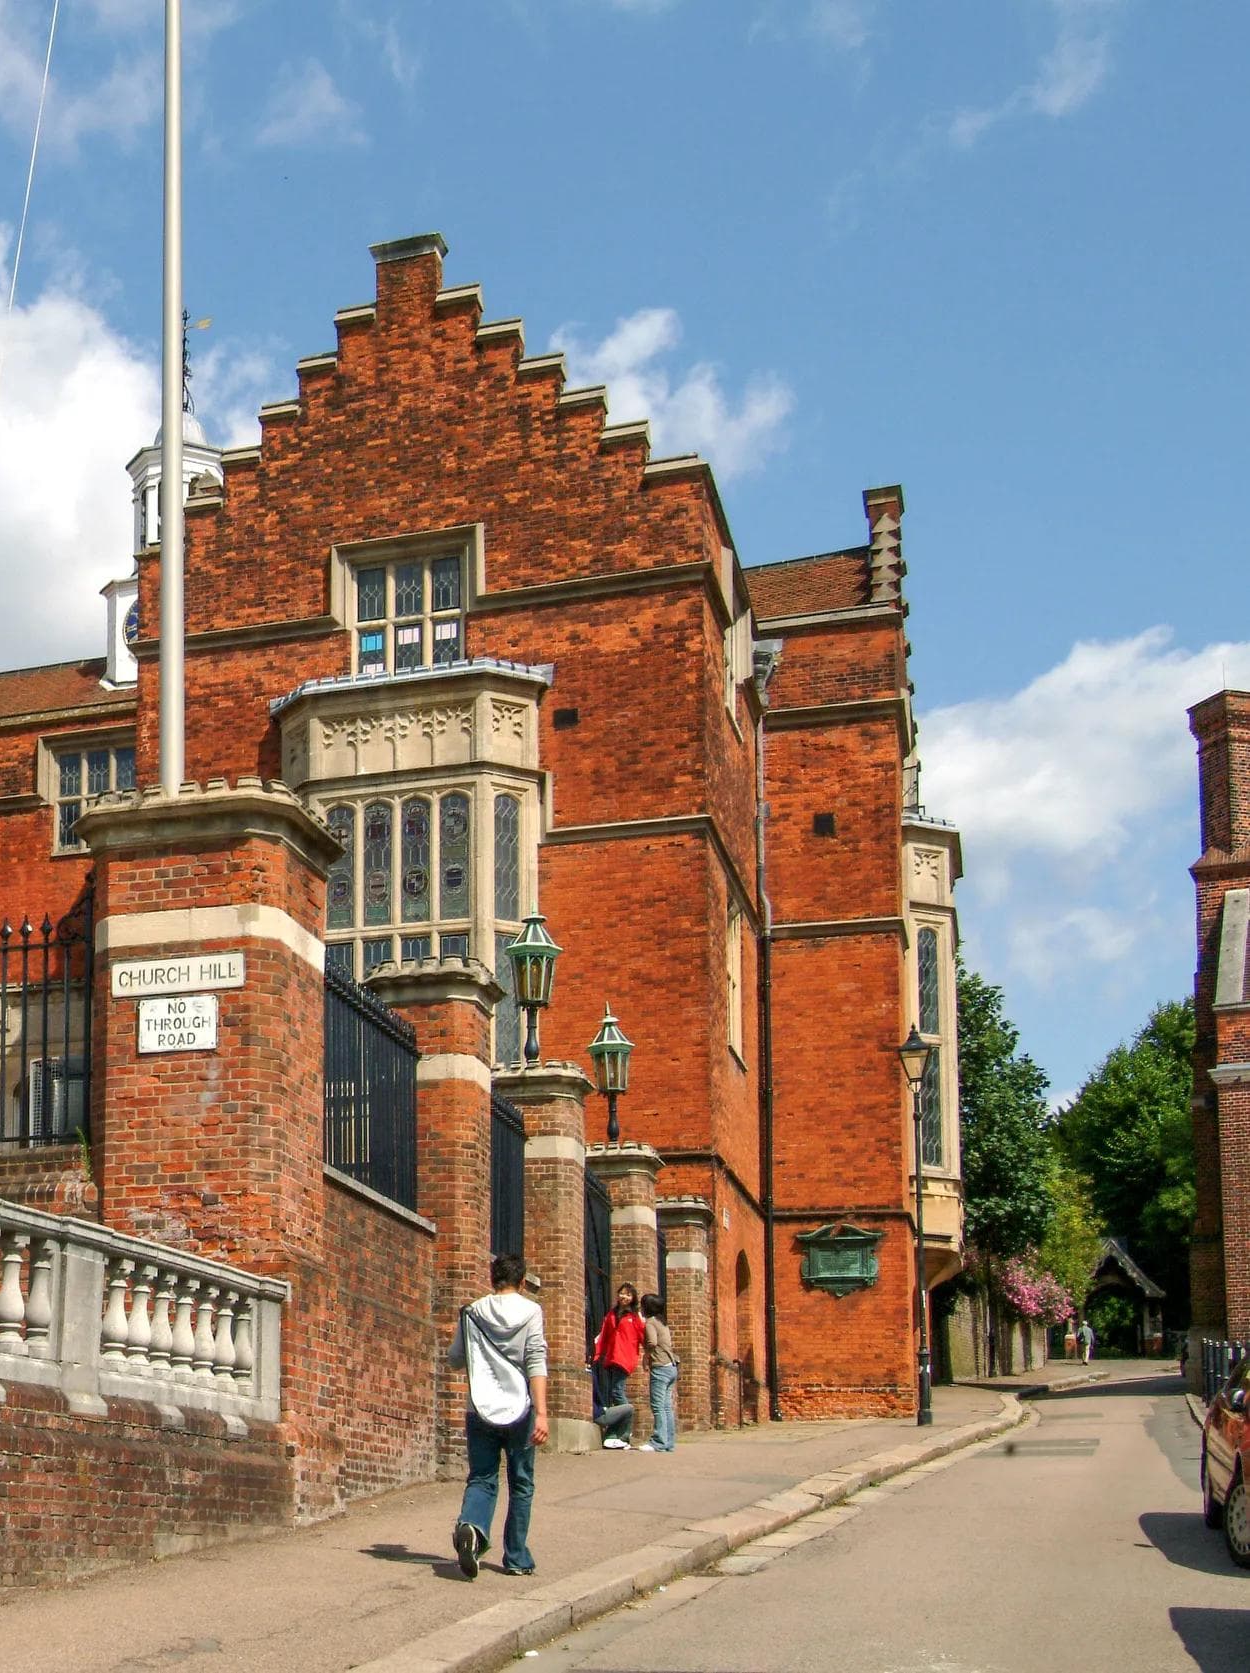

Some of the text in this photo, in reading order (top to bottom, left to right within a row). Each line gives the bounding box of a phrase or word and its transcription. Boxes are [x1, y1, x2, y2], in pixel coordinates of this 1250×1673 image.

[118, 962, 238, 988] CHURCH HILL
[167, 1002, 187, 1015] NO
[144, 1016, 211, 1032] THROUGH
[157, 1032, 196, 1047] ROAD
